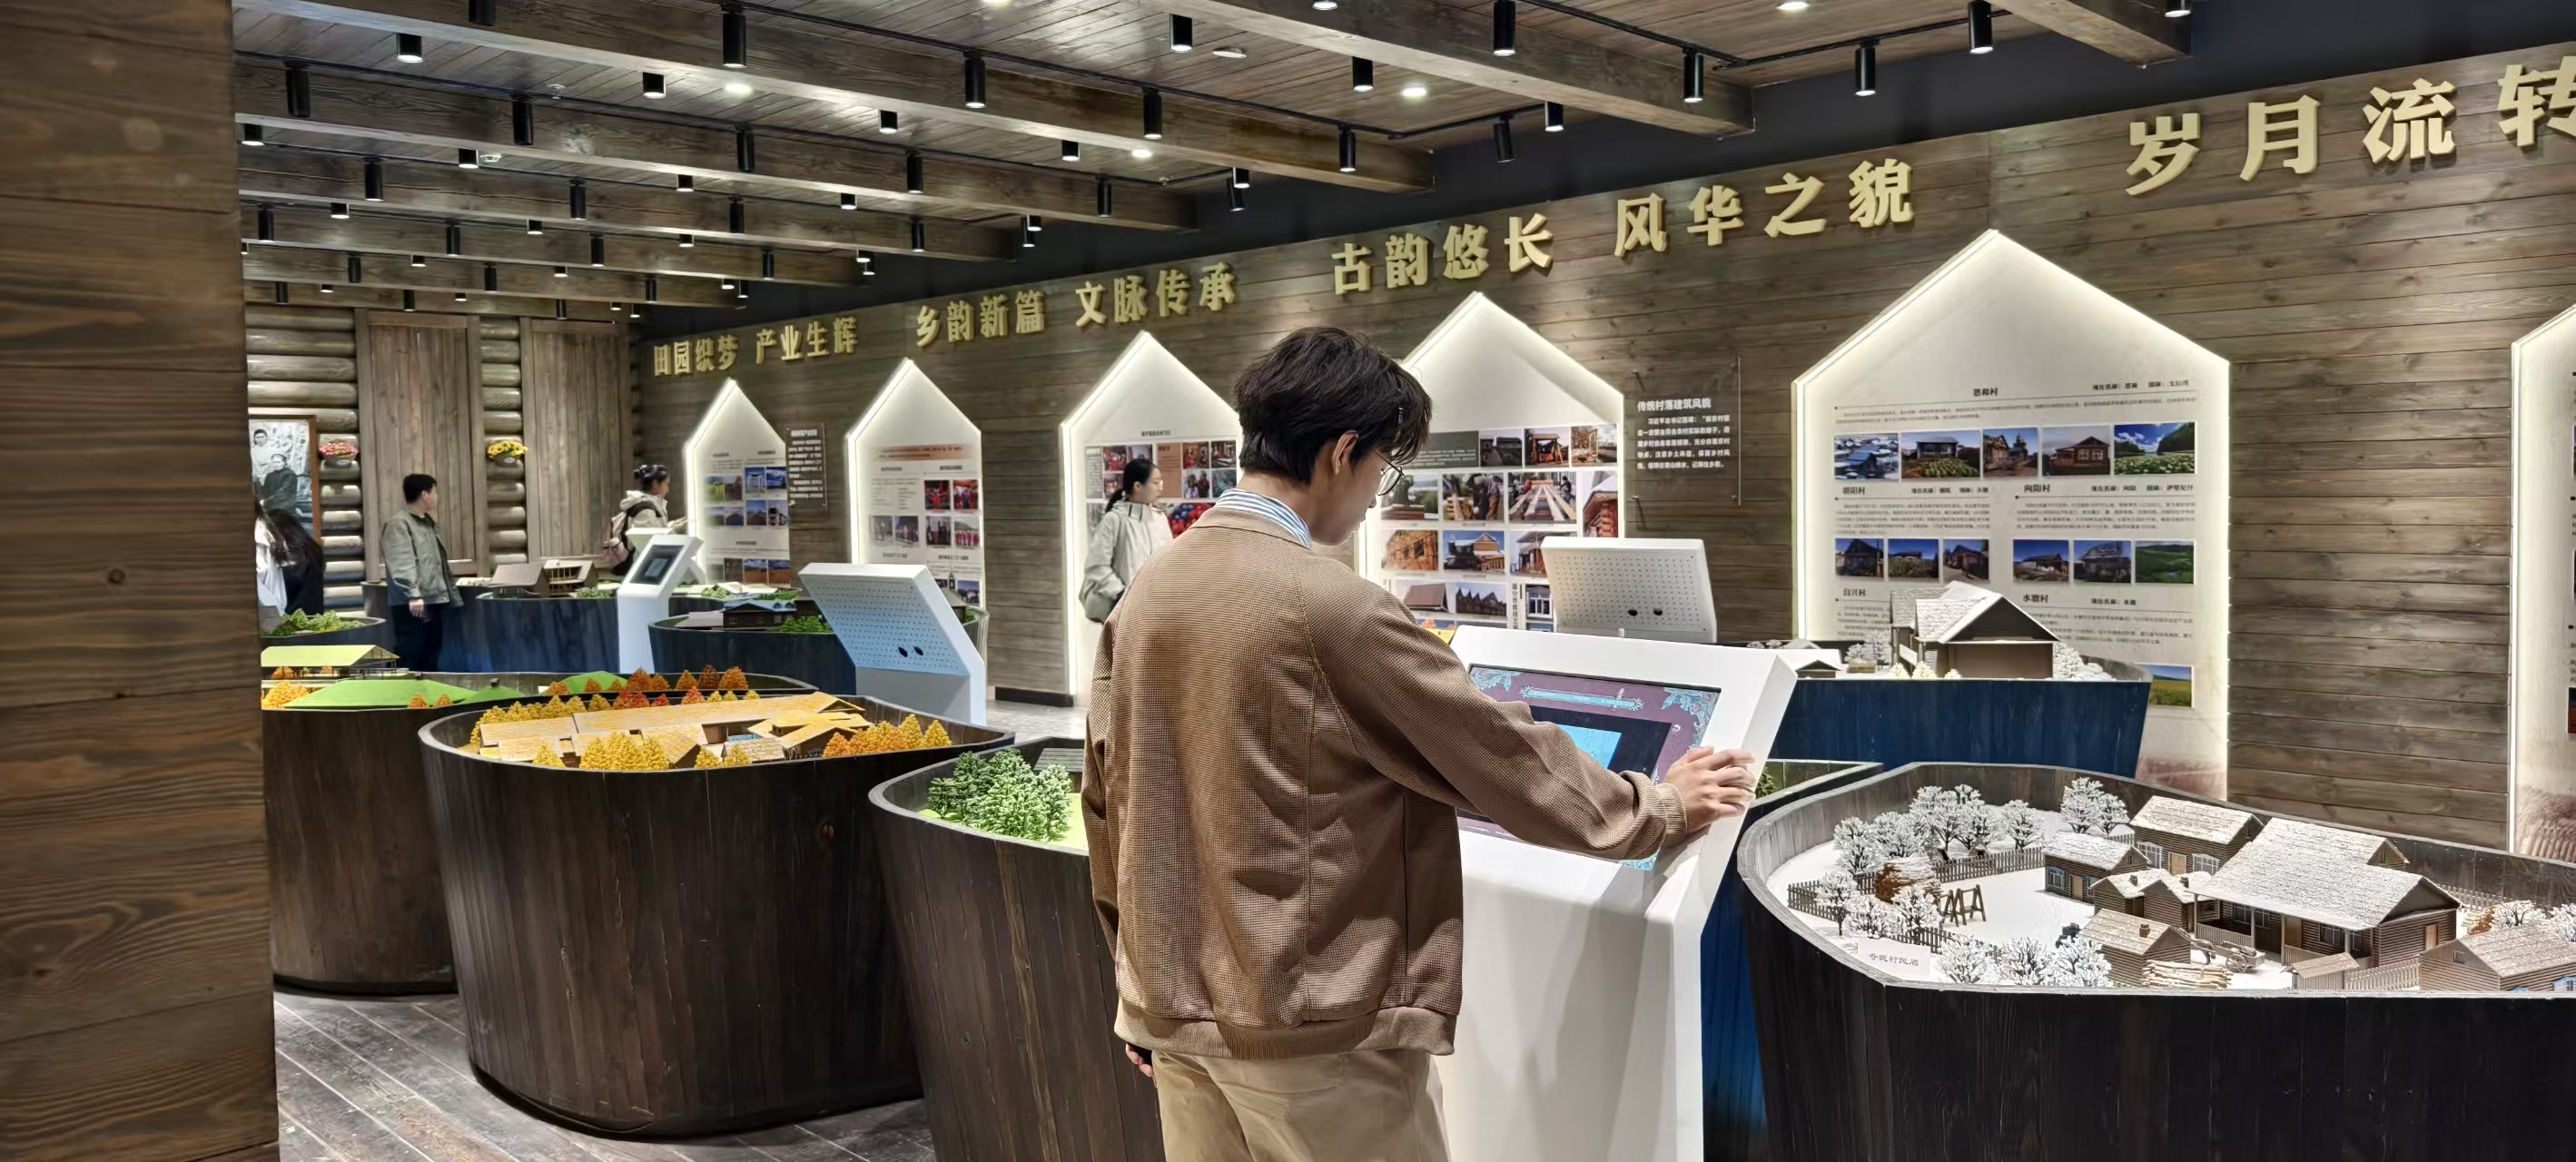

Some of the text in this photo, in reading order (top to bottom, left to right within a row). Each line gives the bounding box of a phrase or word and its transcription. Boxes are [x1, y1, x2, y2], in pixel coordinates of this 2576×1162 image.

[2126, 56, 2576, 196] 岁月流转
[1332, 158, 1914, 295] 古韵悠长 风华之貌
[653, 316, 858, 377] 田园织梦 产业生辉
[915, 261, 1237, 349] 乡韵新篇 文脉传承
[1637, 398, 1712, 412] 传统村落建筑风貌
